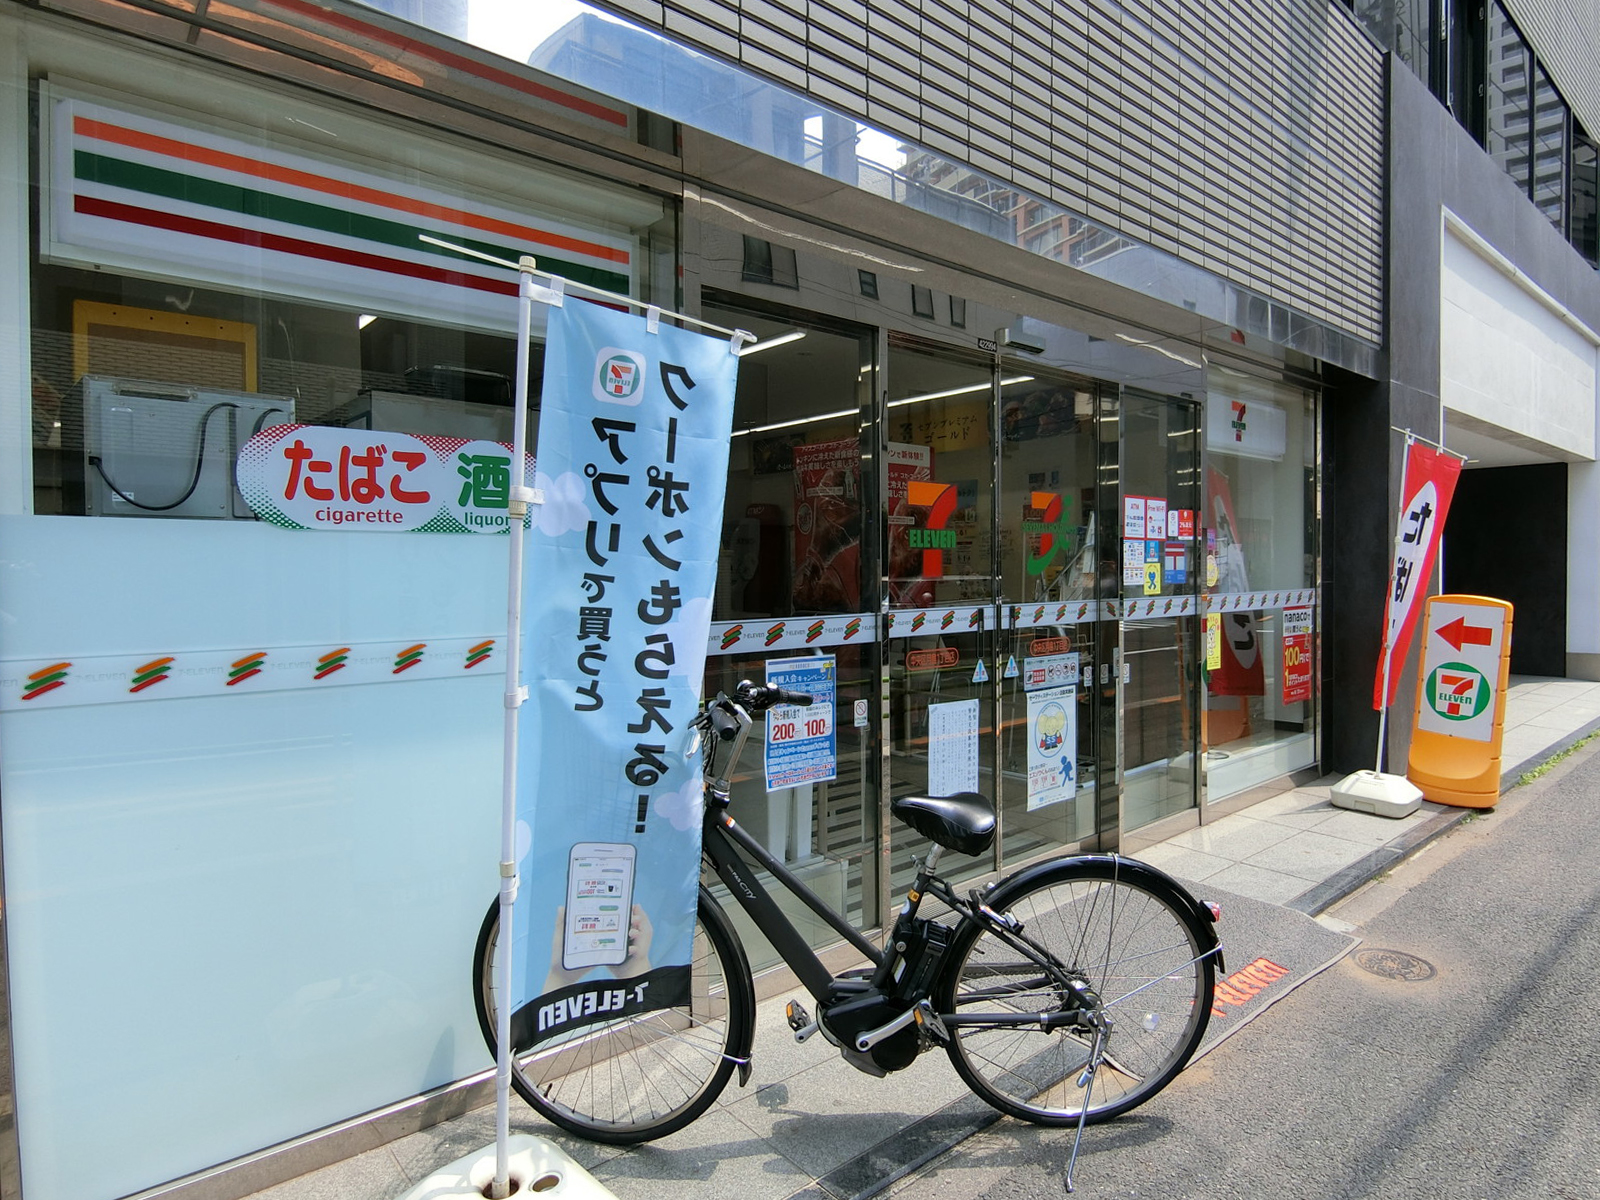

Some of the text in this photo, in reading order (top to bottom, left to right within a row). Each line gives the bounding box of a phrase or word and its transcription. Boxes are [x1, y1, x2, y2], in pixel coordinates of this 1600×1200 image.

[924, 426, 970, 444] ゴールド
[283, 439, 431, 504] たばこ
[457, 452, 511, 508] 酒
[315, 507, 403, 526] cigarette
[907, 481, 958, 578] 7 ELEVEN
[1438, 673, 1475, 716] 7 ELEVEN
